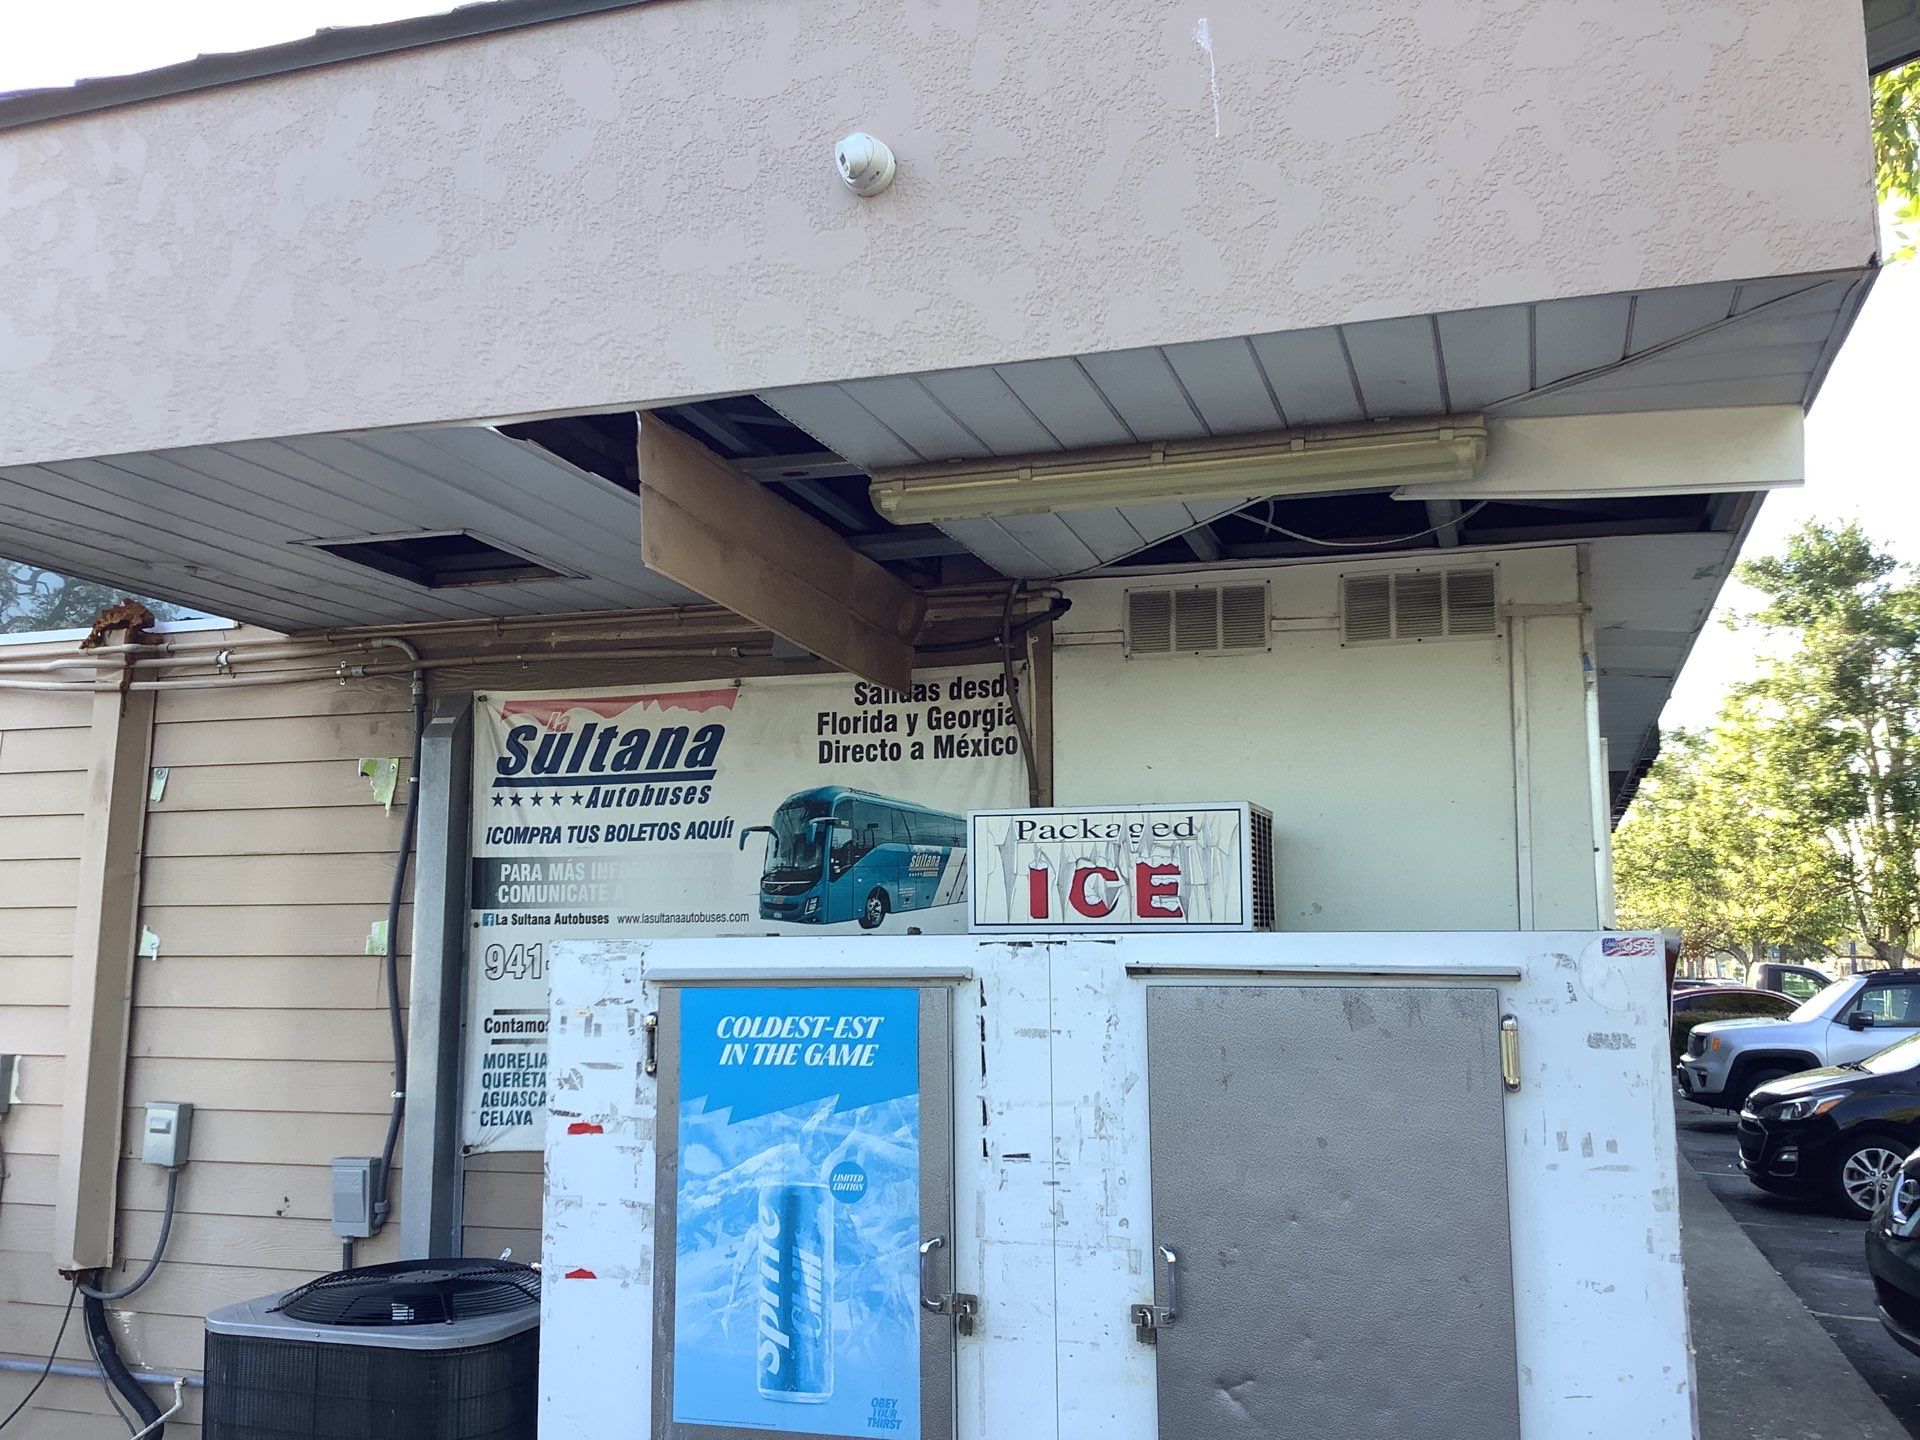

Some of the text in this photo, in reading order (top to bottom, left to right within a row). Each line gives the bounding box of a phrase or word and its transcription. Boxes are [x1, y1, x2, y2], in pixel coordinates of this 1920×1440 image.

[817, 702, 1017, 737] Florida y Georgia
[496, 723, 726, 776] Sultana
[818, 732, 1018, 764] Directo a México
[585, 785, 712, 809] Autobuses
[567, 825, 600, 844] TUS
[604, 822, 680, 843] BOLETOS
[684, 816, 735, 841] AQUÍ!
[1014, 816, 1198, 844] Packaged
[500, 863, 542, 882] PARA
[549, 858, 585, 881] MÁS
[497, 883, 608, 904] COMUNICATE
[1027, 857, 1184, 919] ICE
[495, 914, 508, 926] La
[511, 913, 551, 926] Sultana
[554, 913, 610, 925] Autobuses
[617, 912, 750, 924] www.lasultanaautobuses.com
[716, 1016, 885, 1039] COLDEST-EST
[483, 1053, 547, 1069] MORELIA
[719, 1043, 879, 1067] IN THE GAME
[480, 1091, 547, 1108] AGUASCA
[480, 1110, 533, 1127] CELAYA
[832, 1173, 864, 1182] LIMITED
[832, 1182, 864, 1191] EDITION
[871, 1397, 898, 1409] OBEY
[873, 1408, 898, 1418] YOUR
[867, 1417, 903, 1430] THIRST
